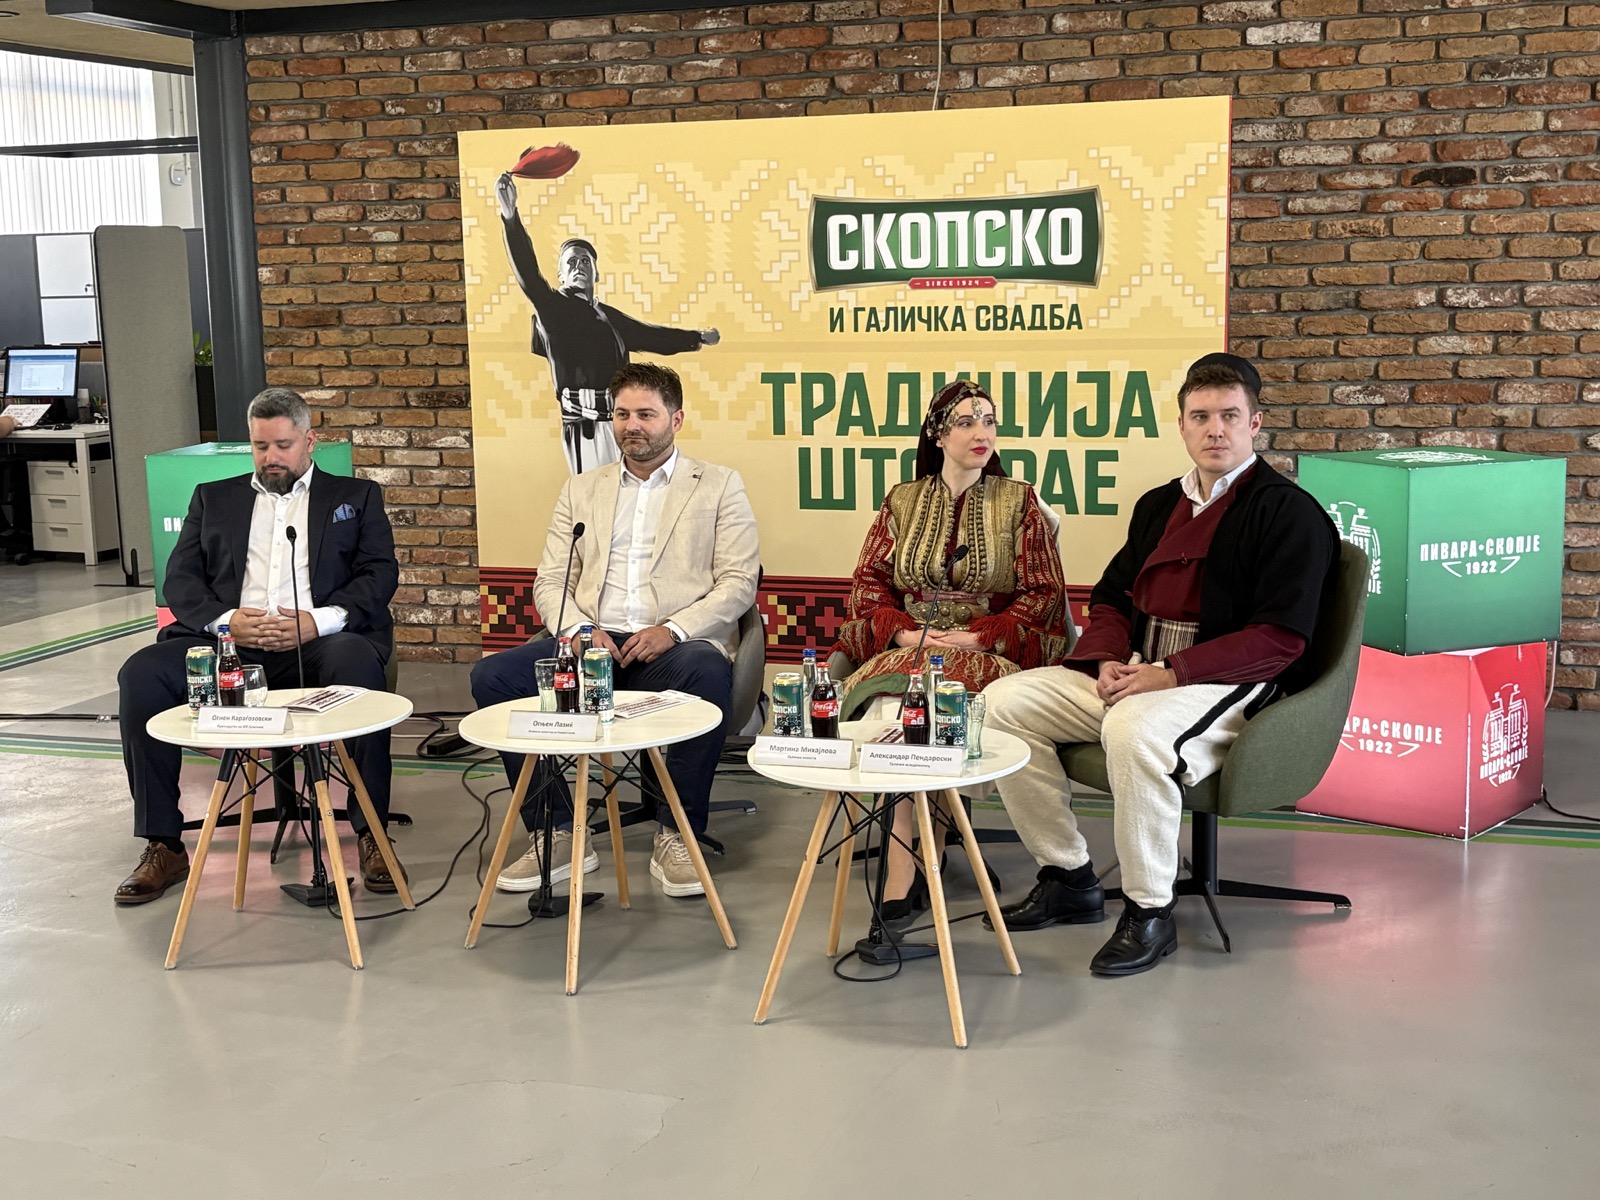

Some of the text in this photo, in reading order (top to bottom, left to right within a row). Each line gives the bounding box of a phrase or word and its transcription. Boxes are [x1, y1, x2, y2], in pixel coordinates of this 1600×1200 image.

[826, 207, 1083, 270] СКОПСКО
[925, 279, 953, 287] SINCE
[829, 303, 1083, 333] И ГАЛИЧКА СВАДБА
[760, 371, 1159, 438] ТРАДЦИЈА
[798, 447, 917, 511] ШТ
[998, 449, 1119, 516] РАЕ
[1465, 560, 1497, 575] 1922
[769, 744, 799, 753] Мартина
[869, 752, 910, 761] Александар
[1358, 738, 1393, 755] 1922
